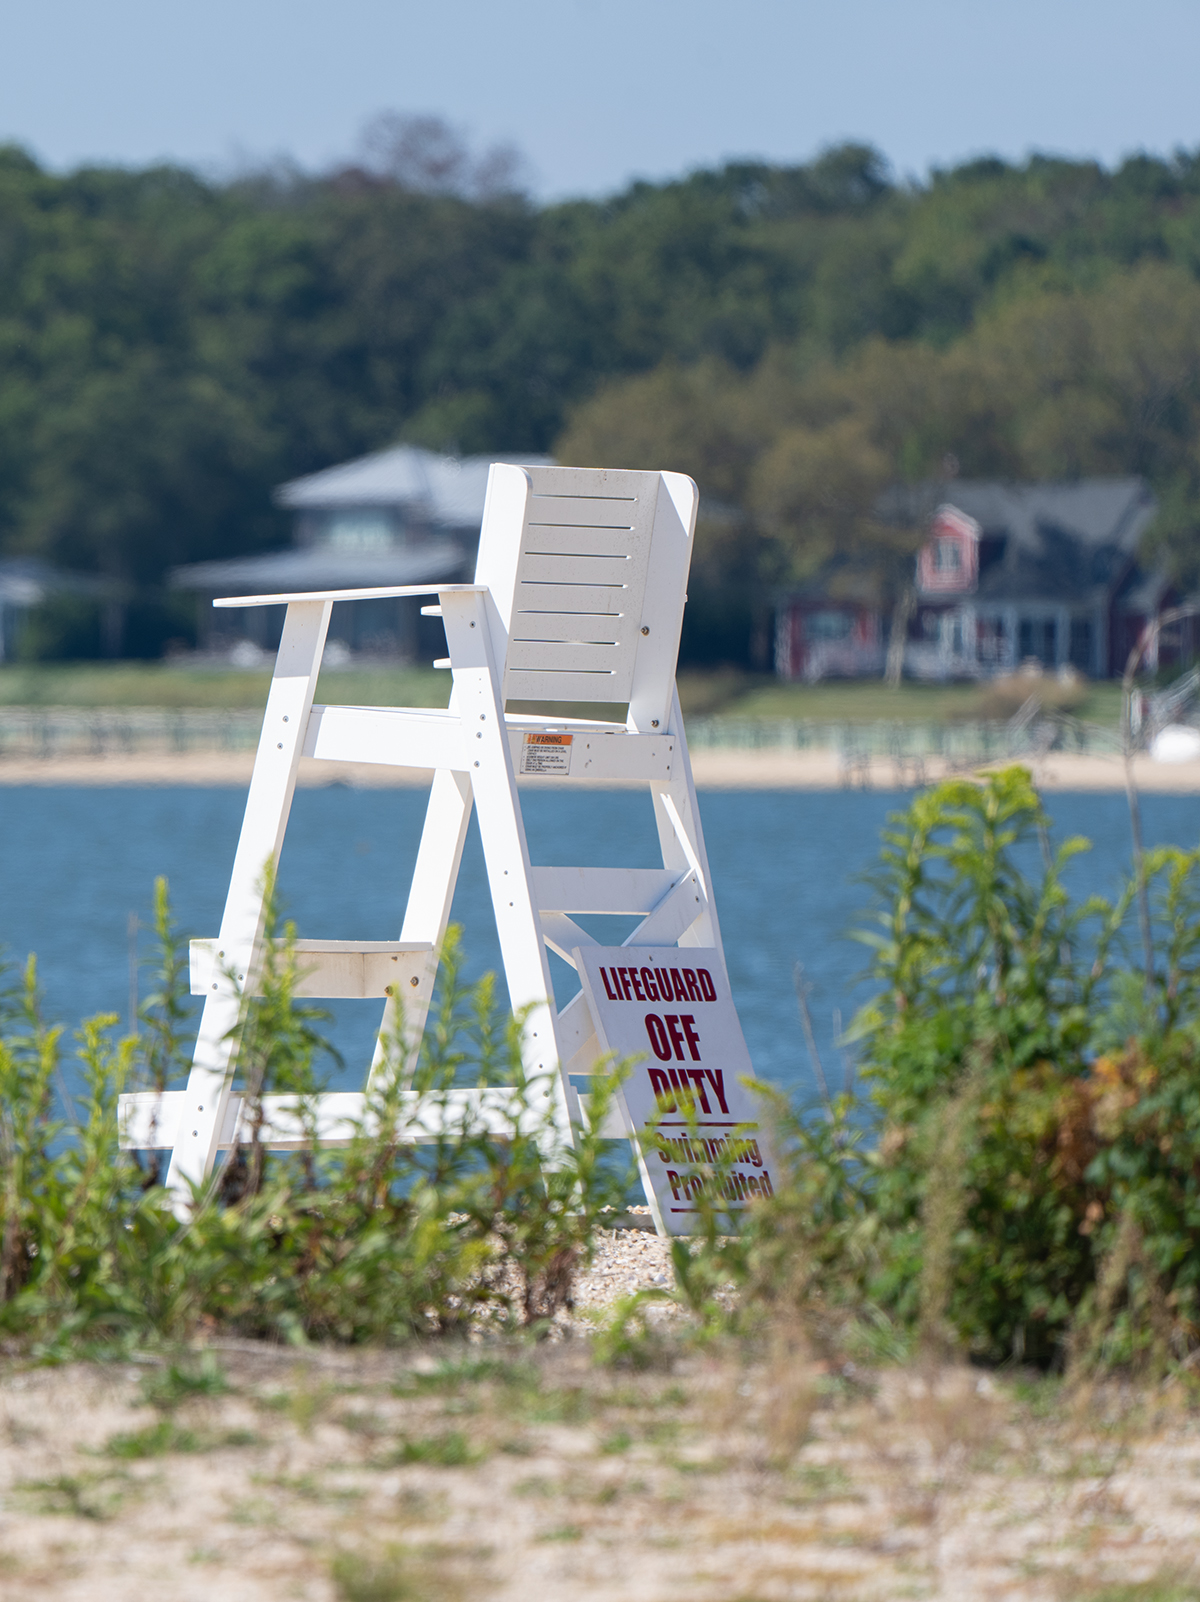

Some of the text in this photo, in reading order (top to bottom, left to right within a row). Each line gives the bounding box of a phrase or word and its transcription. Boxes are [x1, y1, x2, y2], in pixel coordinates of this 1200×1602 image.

[536, 736, 562, 744] WARNING
[599, 966, 718, 1002] LIFEGUARD
[644, 1013, 702, 1061] OFF
[647, 1068, 730, 1114] DUTY
[654, 1132, 763, 1168] Swimming
